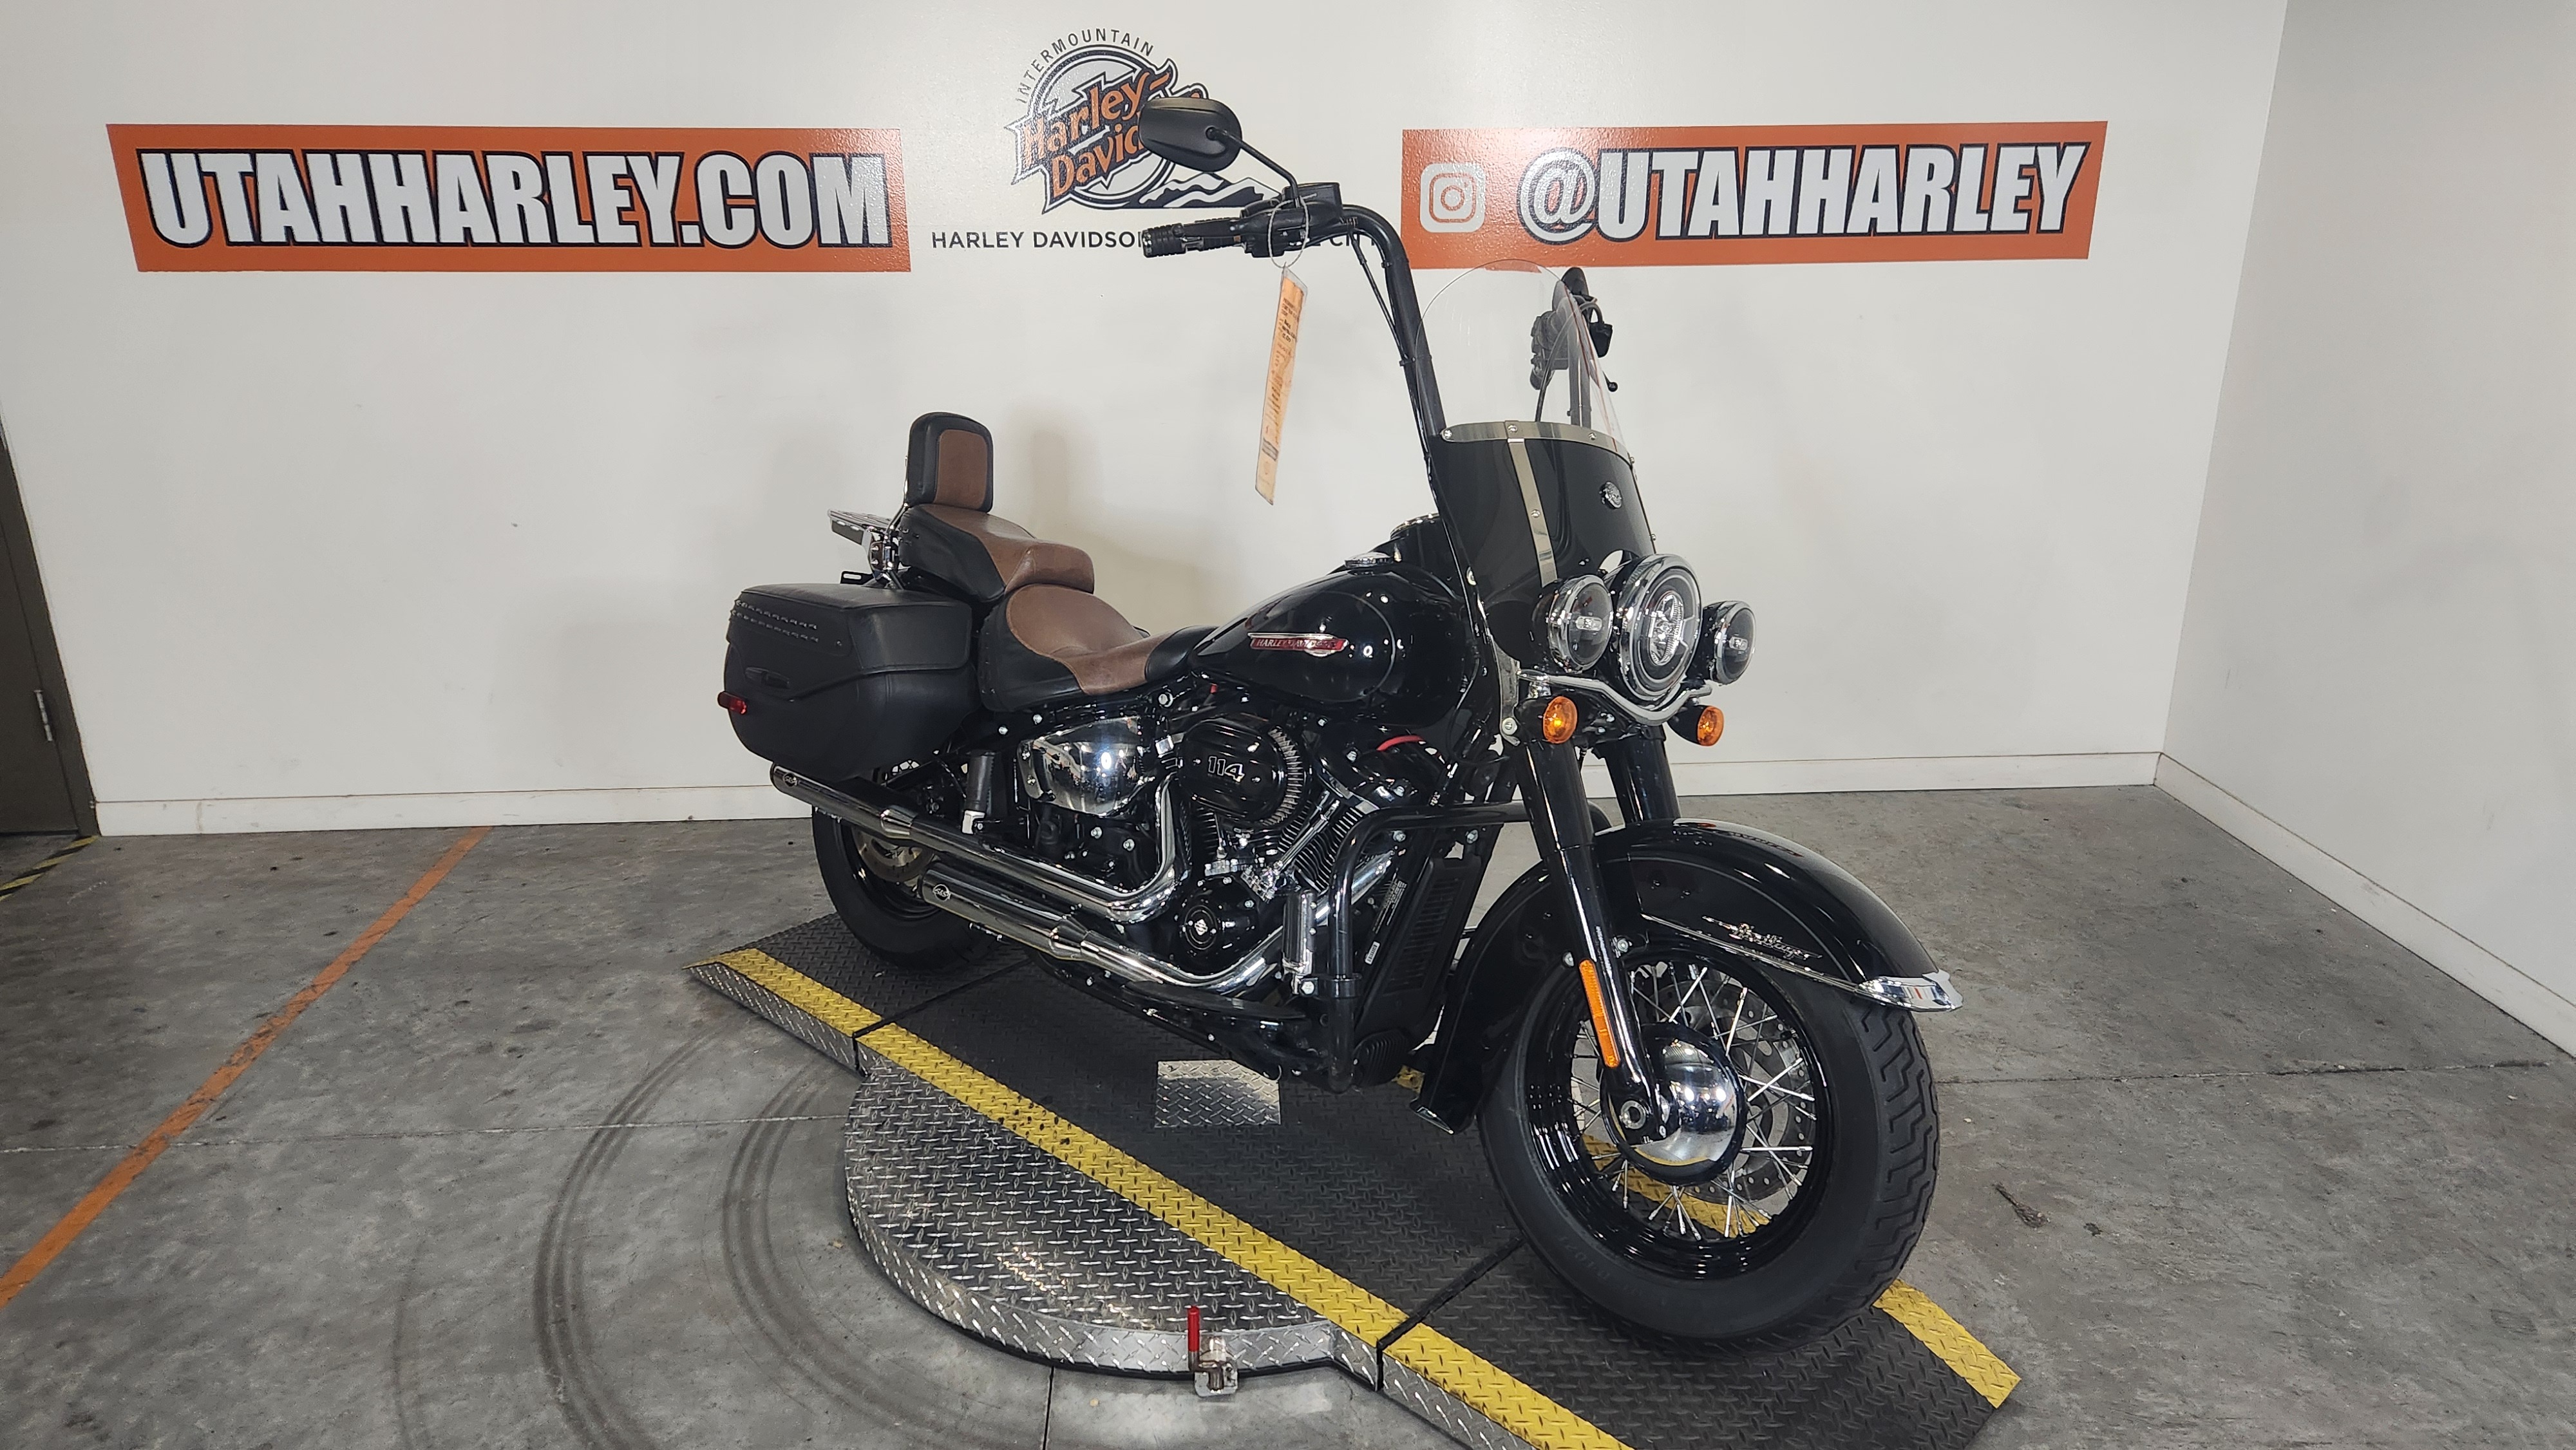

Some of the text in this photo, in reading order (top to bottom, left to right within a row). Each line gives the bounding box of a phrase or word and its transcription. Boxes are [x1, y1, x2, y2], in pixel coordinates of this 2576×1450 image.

[1016, 28, 1155, 104] INTERMOUNTAIN
[137, 149, 893, 249] UTAHHARLEY.COM
[1517, 142, 2091, 245] @UTAHHARLEY
[932, 231, 1025, 249] HARLEY
[1033, 231, 1143, 249] DAVIDSO
[1208, 756, 1245, 782] 114
